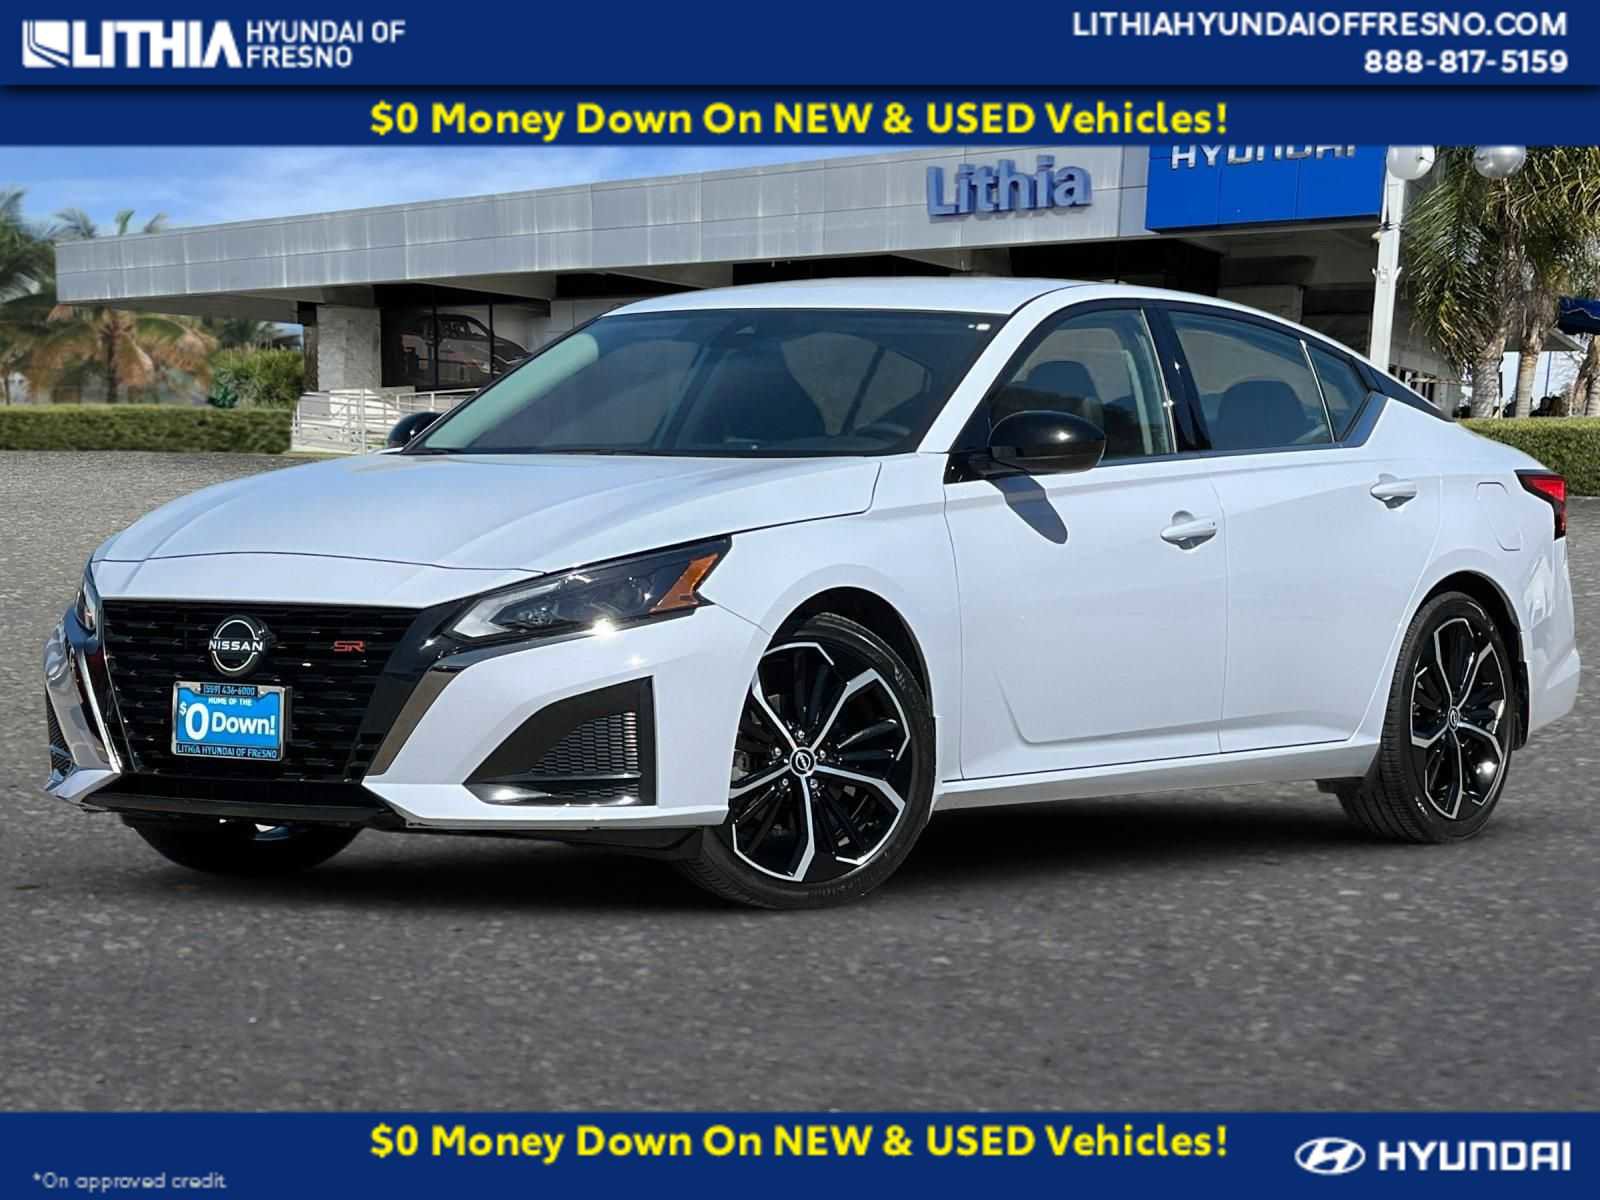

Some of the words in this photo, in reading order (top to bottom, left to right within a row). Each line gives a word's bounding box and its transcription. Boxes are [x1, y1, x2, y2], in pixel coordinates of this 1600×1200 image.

[926, 154, 1092, 217] Lithia
[208, 639, 263, 651] NISSAN
[333, 640, 365, 652] SR
[211, 711, 276, 736] Down!
[202, 745, 235, 756] HYUNDAI
[236, 747, 245, 757] OF
[247, 748, 277, 759] FRESNO
